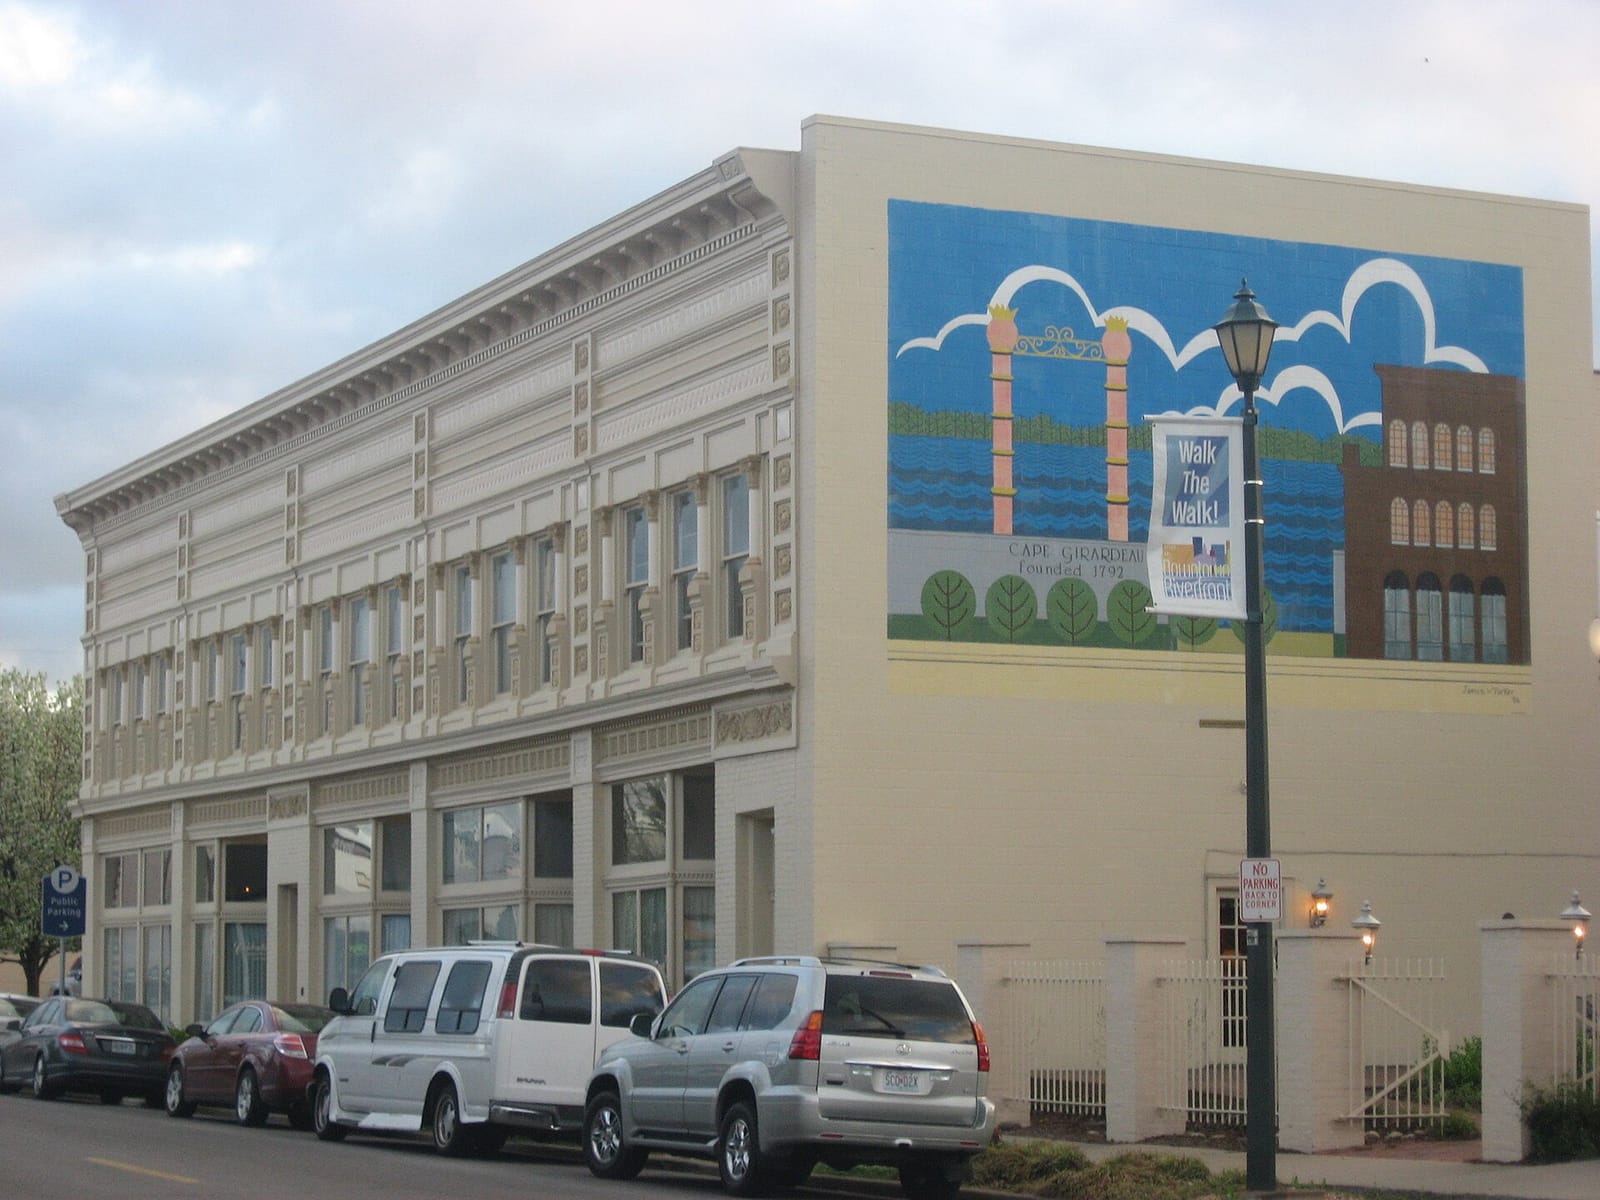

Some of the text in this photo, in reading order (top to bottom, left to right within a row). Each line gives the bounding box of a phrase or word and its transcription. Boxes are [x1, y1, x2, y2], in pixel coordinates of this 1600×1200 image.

[1178, 439, 1217, 465] Walk
[1183, 469, 1210, 494] The
[1172, 500, 1219, 525] Walk!
[1009, 542, 1144, 564] CAPE GIRARDEAU
[1092, 565, 1125, 579] 1792
[1163, 576, 1233, 601] Riverfront
[1252, 864, 1268, 876] NO
[1243, 879, 1278, 889] PARKING
[1245, 891, 1278, 900] BACK TO
[1245, 900, 1277, 909] CORNER
